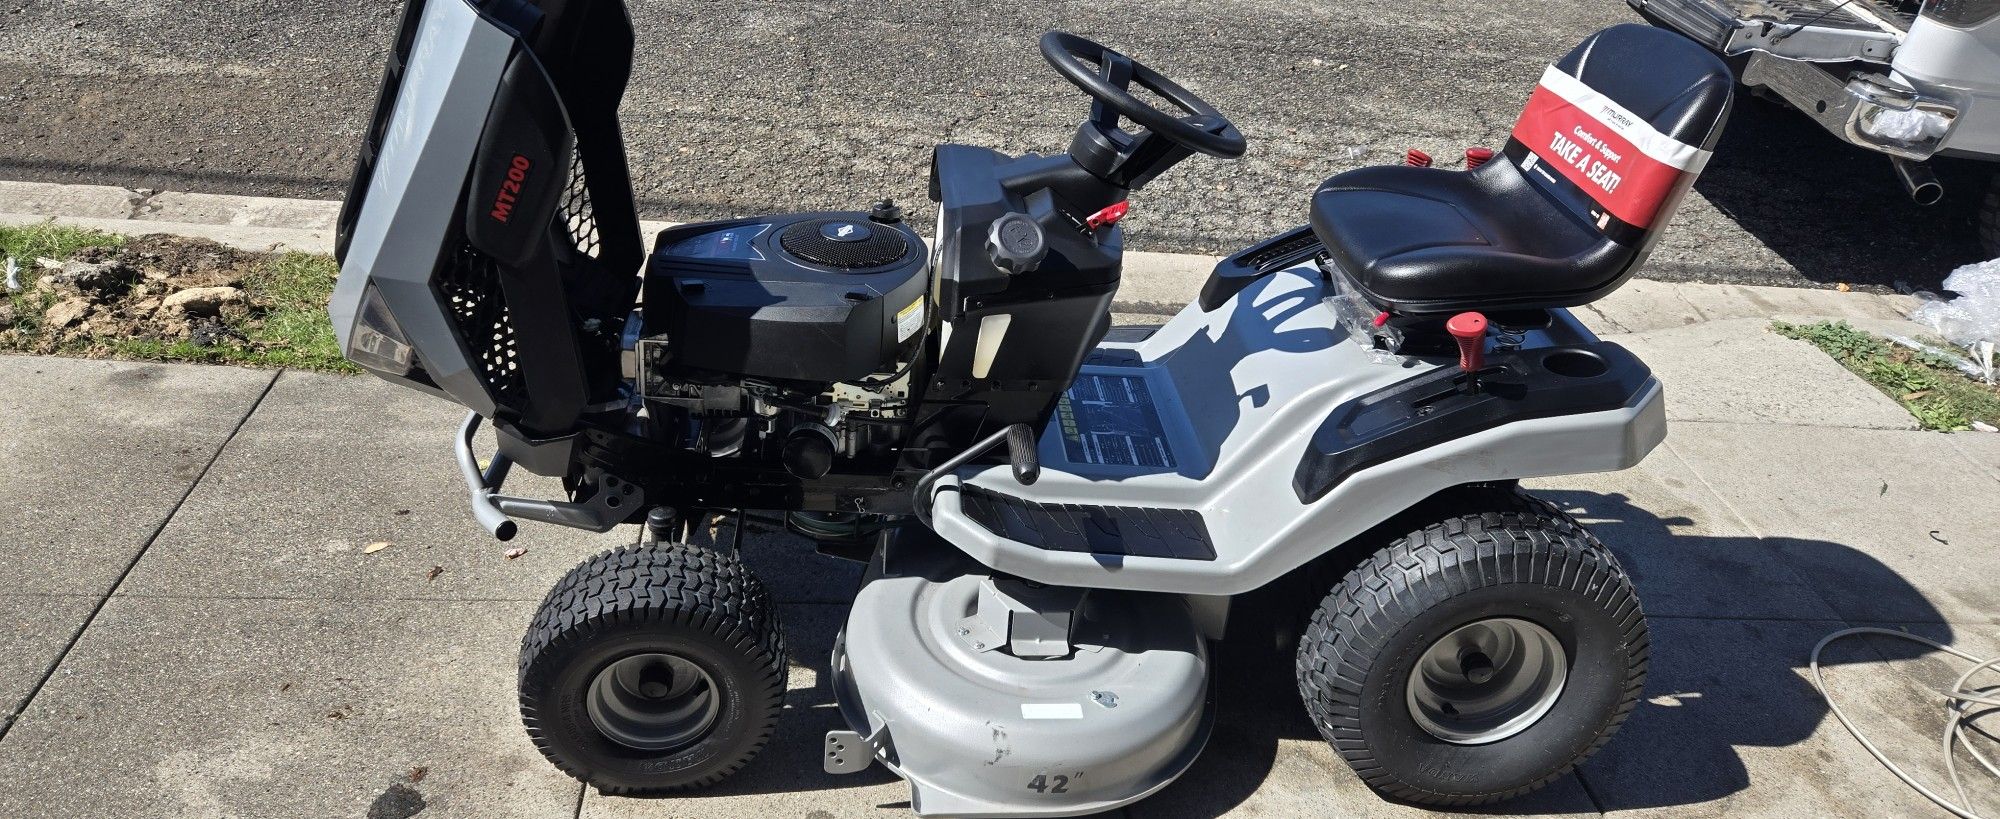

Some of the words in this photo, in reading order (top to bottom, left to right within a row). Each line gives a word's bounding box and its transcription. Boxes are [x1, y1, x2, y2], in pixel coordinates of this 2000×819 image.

[1550, 131, 1583, 164] TAKE
[1575, 154, 1591, 173] A
[1586, 160, 1621, 194] SEAT!
[1574, 125, 1597, 147] Comfort
[1595, 140, 1602, 150] &
[1600, 143, 1621, 163] Support
[491, 155, 529, 222] MT200
[1027, 771, 1084, 793] 42"
